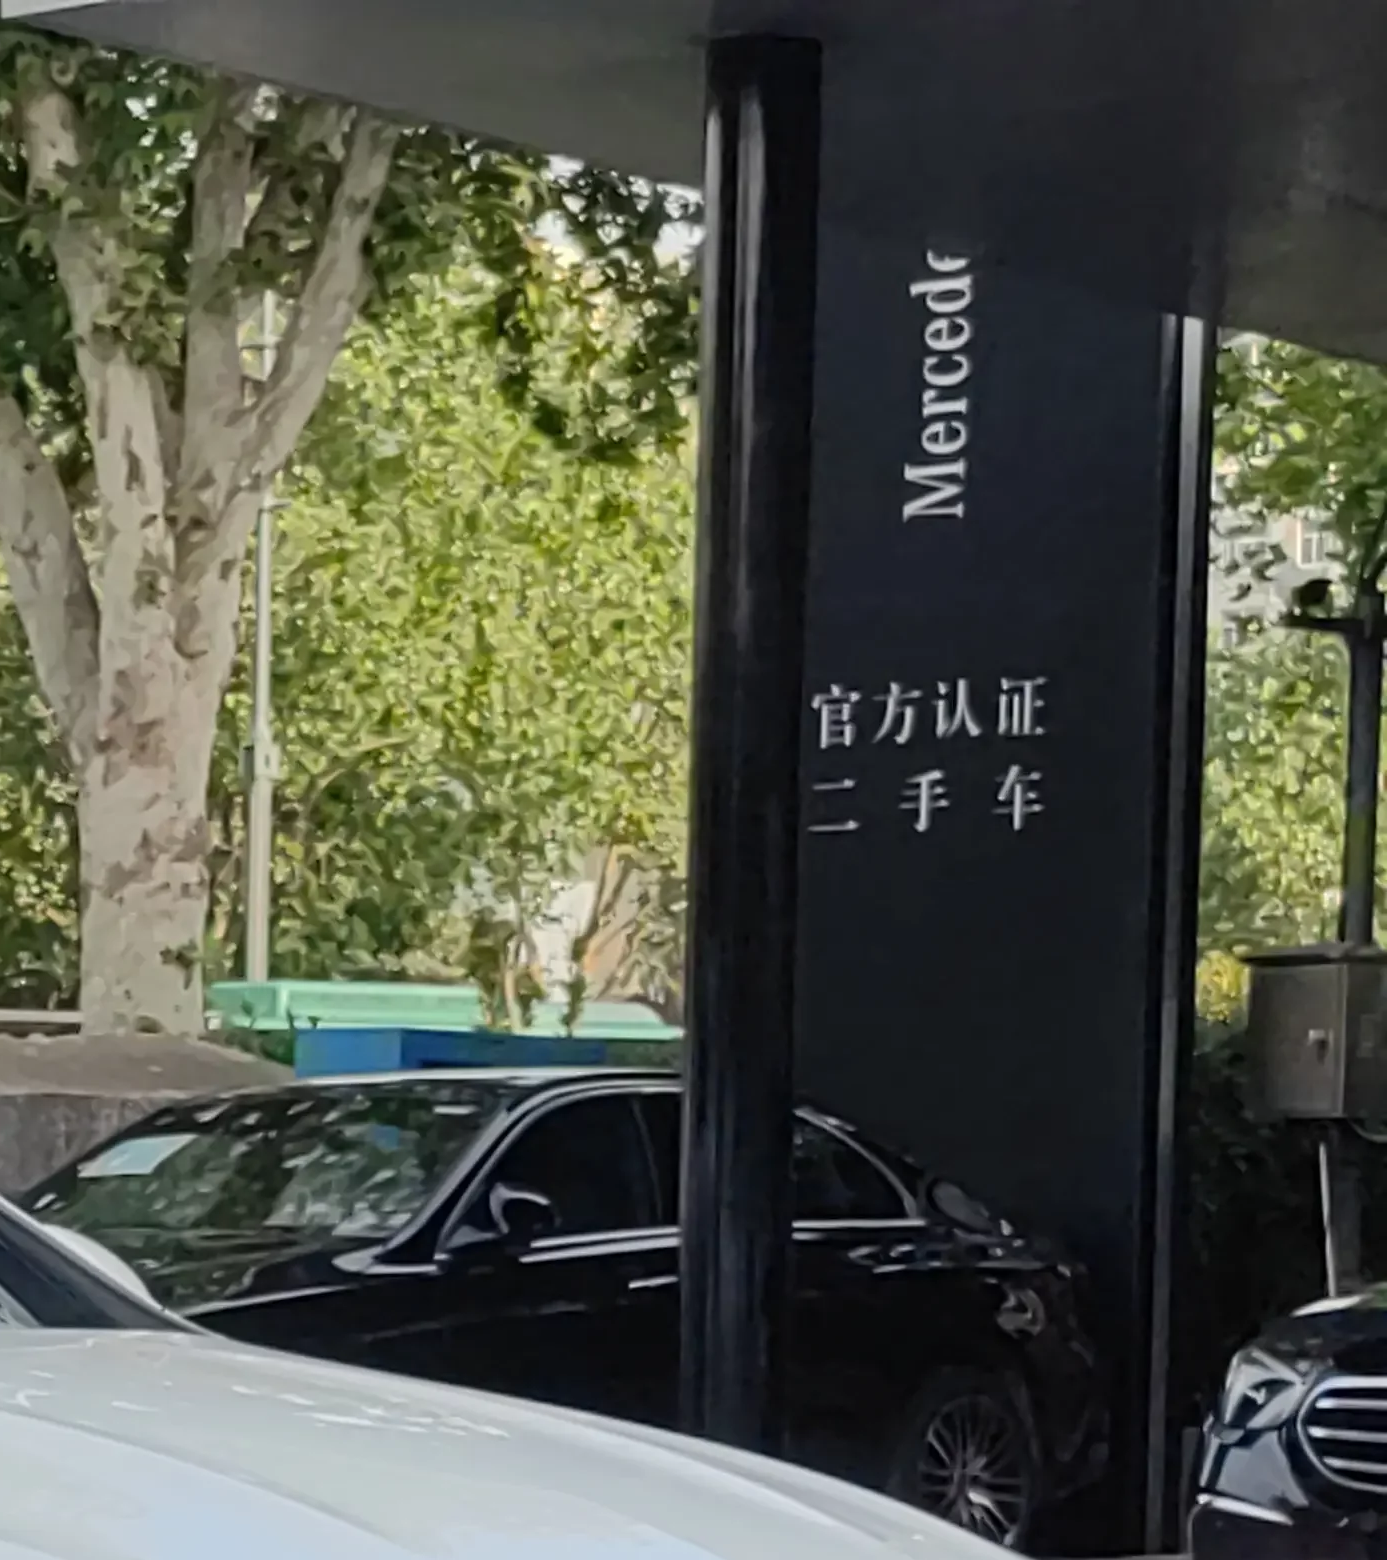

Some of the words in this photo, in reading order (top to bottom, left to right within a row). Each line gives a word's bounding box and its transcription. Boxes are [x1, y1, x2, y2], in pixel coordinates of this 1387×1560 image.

[811, 677, 1049, 748] 官方认证
[808, 765, 1044, 832] 二手车
